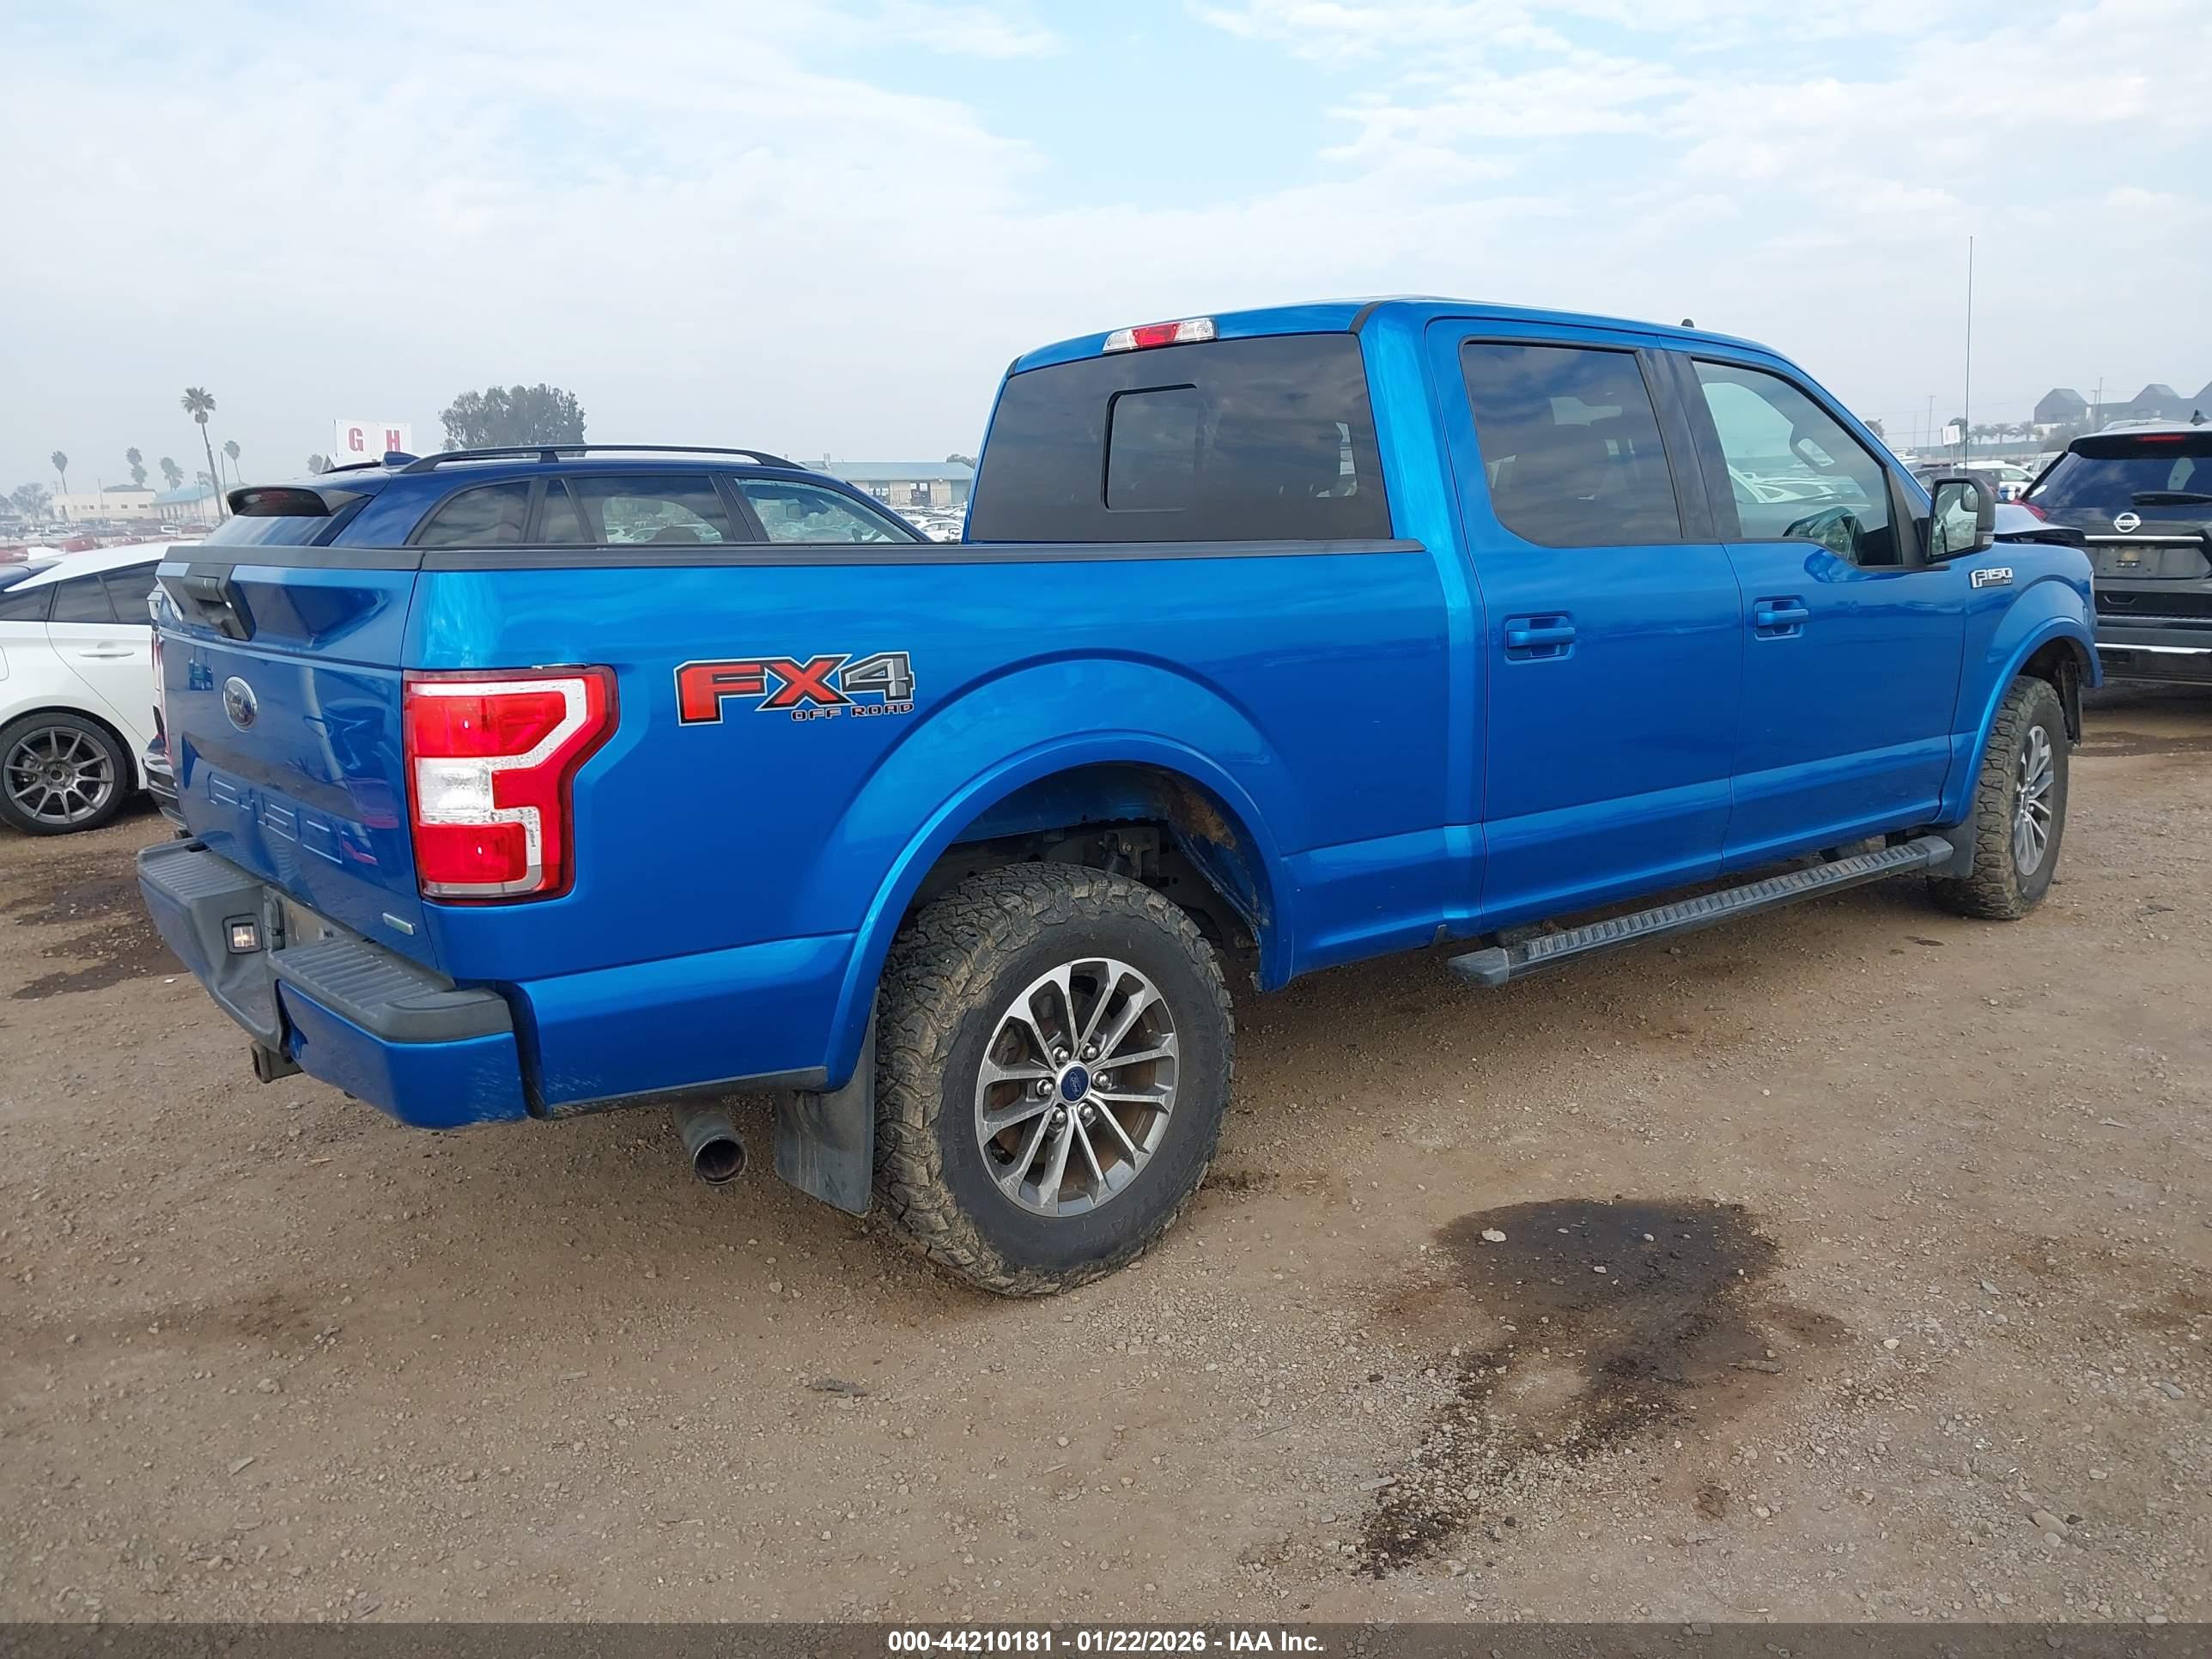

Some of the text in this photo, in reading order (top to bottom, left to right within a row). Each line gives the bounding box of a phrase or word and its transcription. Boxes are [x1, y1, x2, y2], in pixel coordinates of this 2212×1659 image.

[348, 427, 401, 453] G H
[673, 651, 915, 726] FX4
[790, 702, 915, 722] OFF ROAD
